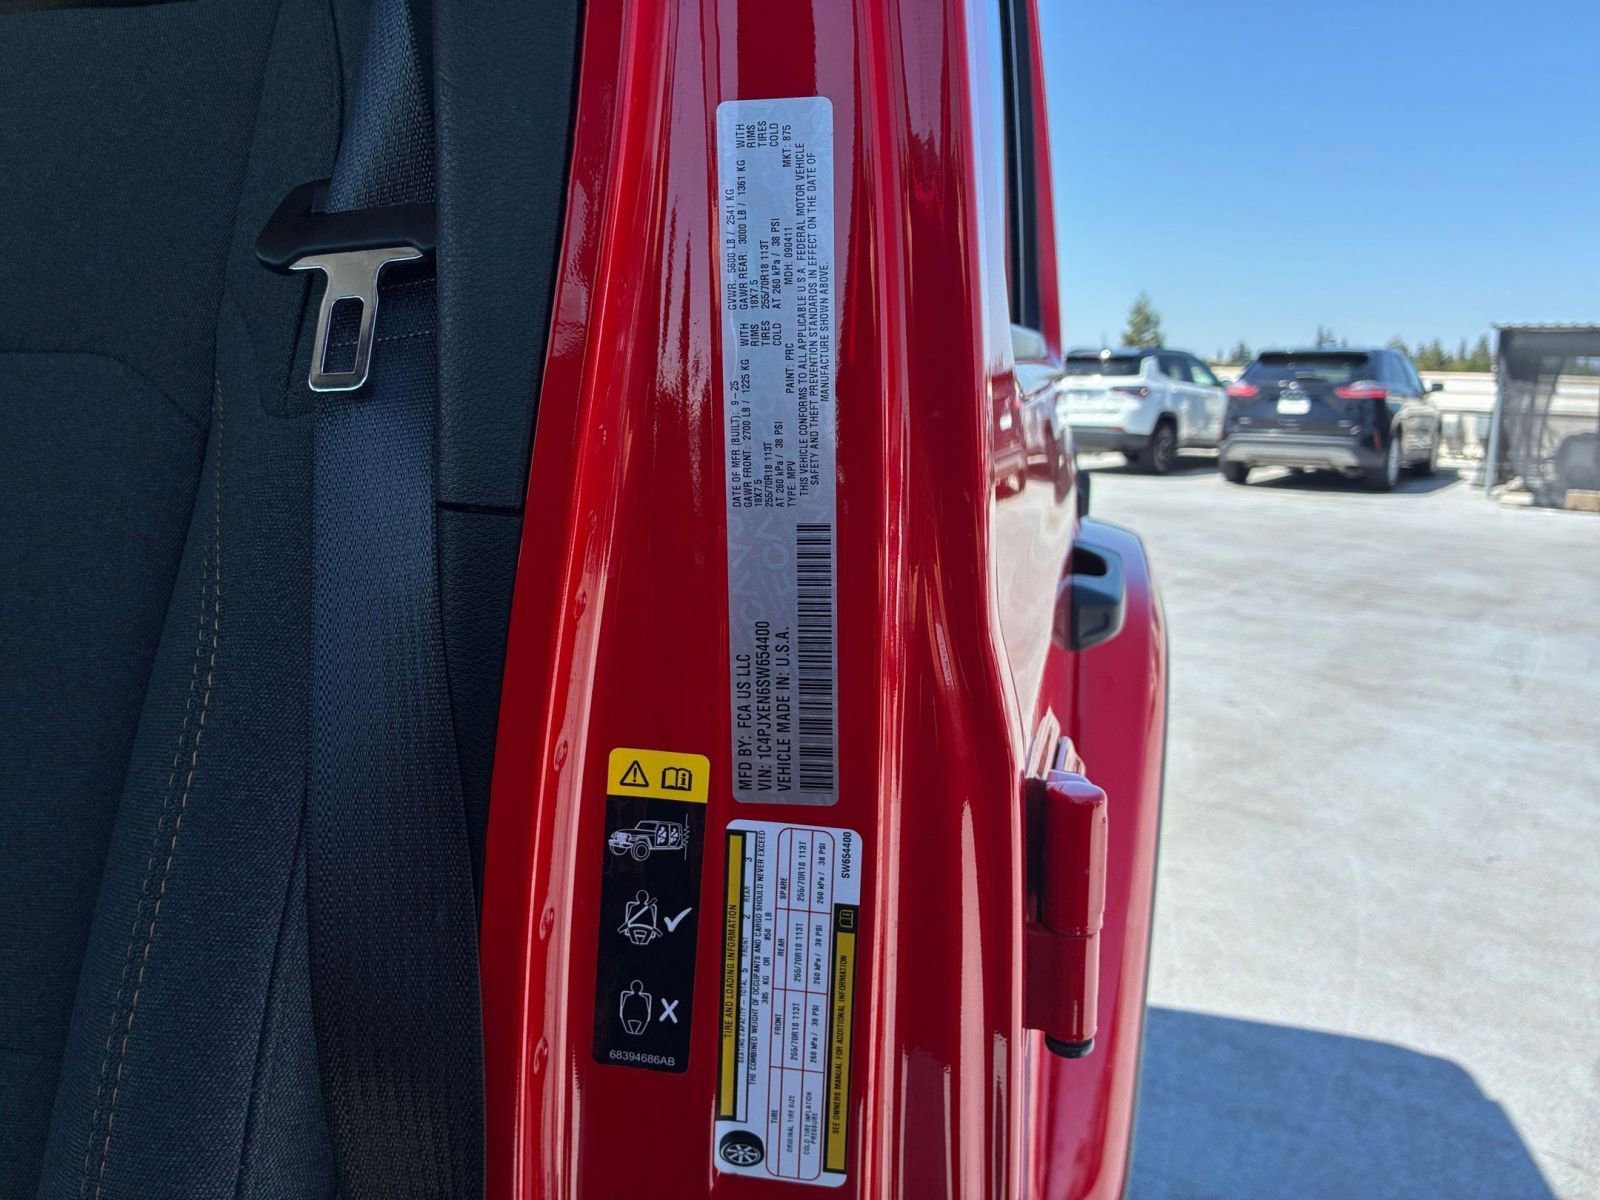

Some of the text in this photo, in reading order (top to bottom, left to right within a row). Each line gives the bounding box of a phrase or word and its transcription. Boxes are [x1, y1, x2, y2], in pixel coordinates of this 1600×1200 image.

[736, 124, 745, 148] WITH
[747, 125, 755, 148] RIMS
[758, 120, 766, 147] TIRES
[770, 123, 778, 147] COLD
[783, 125, 791, 167] MKT: 875
[737, 160, 745, 171] KG
[738, 210, 746, 220] LB
[726, 189, 737, 310] GVWR: 5600 LB 2541 KG
[739, 251, 747, 278] REAR:
[771, 218, 780, 309] AT 260 kPa 38 PSI
[784, 227, 793, 285] MDH: 090411
[760, 240, 769, 309] 255/70R18 113T
[740, 280, 748, 310] GAWR
[740, 323, 748, 346] WITH
[751, 324, 759, 346] RIMS
[762, 321, 770, 346] TIRES
[773, 323, 781, 346] COLD
[795, 142, 808, 496] THIS VEHICLE CONFORMS TO ALL APPLICABLE U.S.A. FEDERAL MOTOR VEHICLE
[807, 152, 819, 485] SAFETY AND THEFT PREVENTION STANDARDS IN EFFECT ON THE DATE OF
[819, 262, 829, 401] MANUFACTURE SHOWN ABOVE.
[786, 343, 794, 393] PAINT: PRC
[731, 412, 741, 446] (BUILT):
[741, 359, 752, 507] GAWR FRONT: 2700 LB 1225 KG
[732, 450, 740, 468] MFR
[764, 442, 773, 507] 255/70R18 113T
[774, 422, 784, 507] AT 260 kPa 38 PSI
[732, 471, 741, 482] OF
[754, 480, 763, 507] 18X7.5
[787, 461, 796, 507] TYPE: MPV
[733, 486, 741, 507] DATE
[736, 654, 752, 790] MFD BY: FCA US LLC
[756, 621, 771, 791] VIN: 1C4PJXEN6SW654400
[775, 627, 791, 791] VEHICLE MADE IN: U.S.A.
[818, 857, 826, 866] 38
[841, 832, 852, 878] SW654400
[797, 862, 806, 902] 255/70R18
[728, 904, 736, 960] INFORMATION
[765, 912, 772, 921] LB
[794, 923, 803, 982] 255/70R18 113T
[814, 938, 822, 947] 38
[763, 957, 770, 966] OR
[839, 955, 847, 1002] INFORMATION
[726, 963, 734, 998] LOADING
[762, 976, 770, 984] KG
[725, 1002, 733, 1017] AND
[836, 1005, 844, 1043] ADDITIONAL
[609, 1049, 676, 1066] 68394686AB
[791, 1023, 799, 1060] 255/70R18
